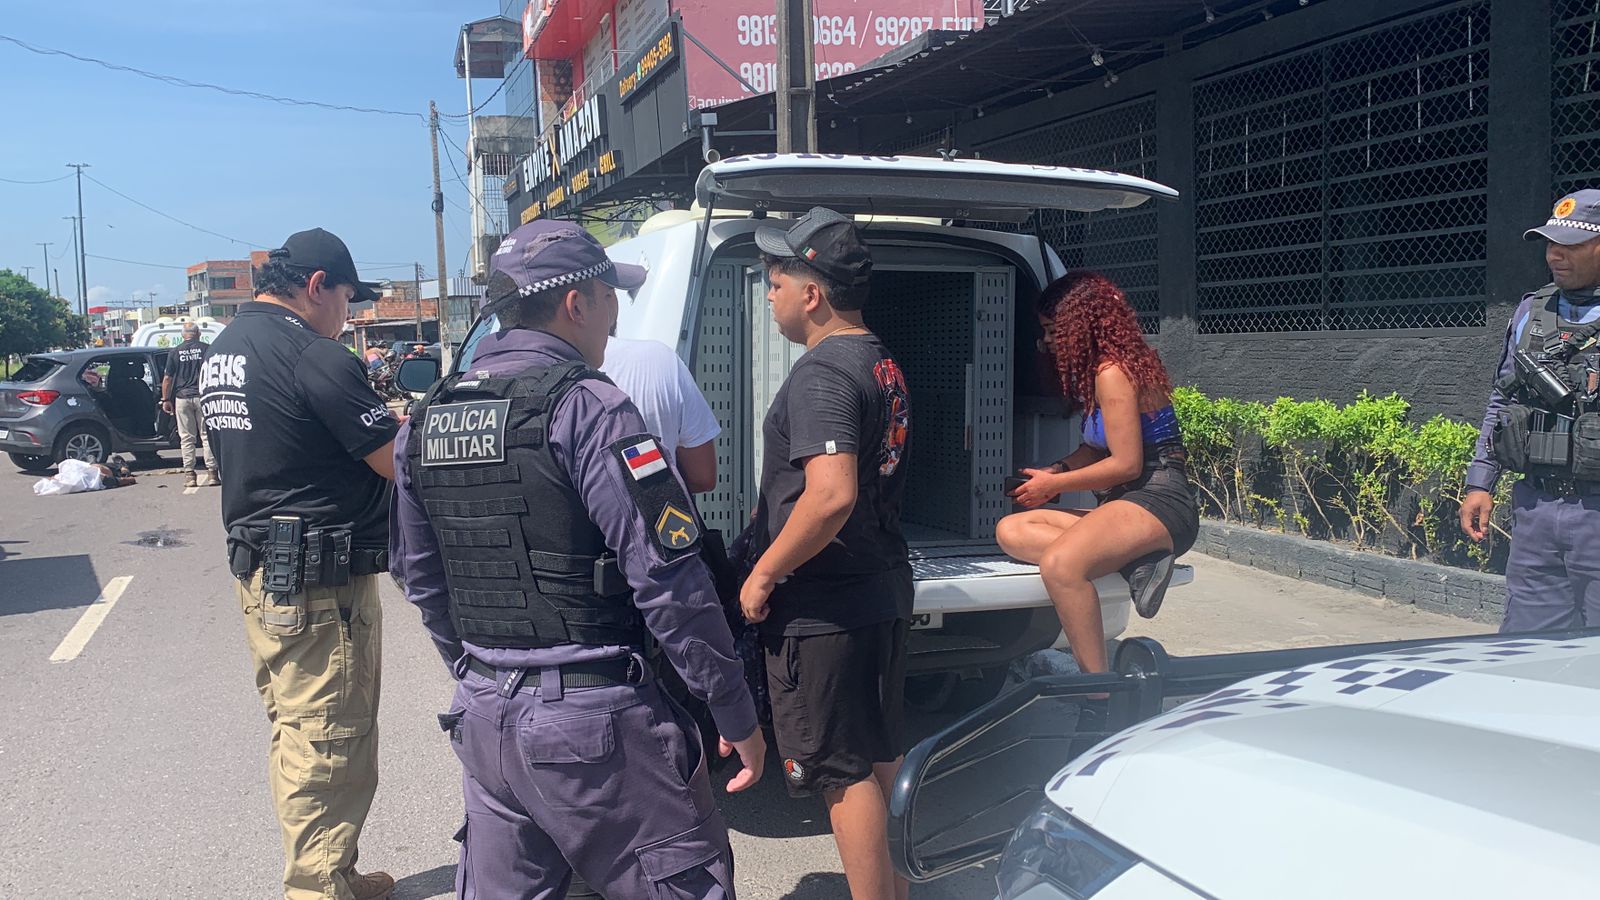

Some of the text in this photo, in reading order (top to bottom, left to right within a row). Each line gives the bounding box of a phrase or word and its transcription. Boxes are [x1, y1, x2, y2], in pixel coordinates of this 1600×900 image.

[523, 94, 600, 192] EMPIRE X AMAZON
[600, 150, 617, 175] GRILL
[199, 353, 247, 394] DEHS
[427, 406, 497, 434] POLÍCIA
[426, 434, 497, 460] MILITAR
